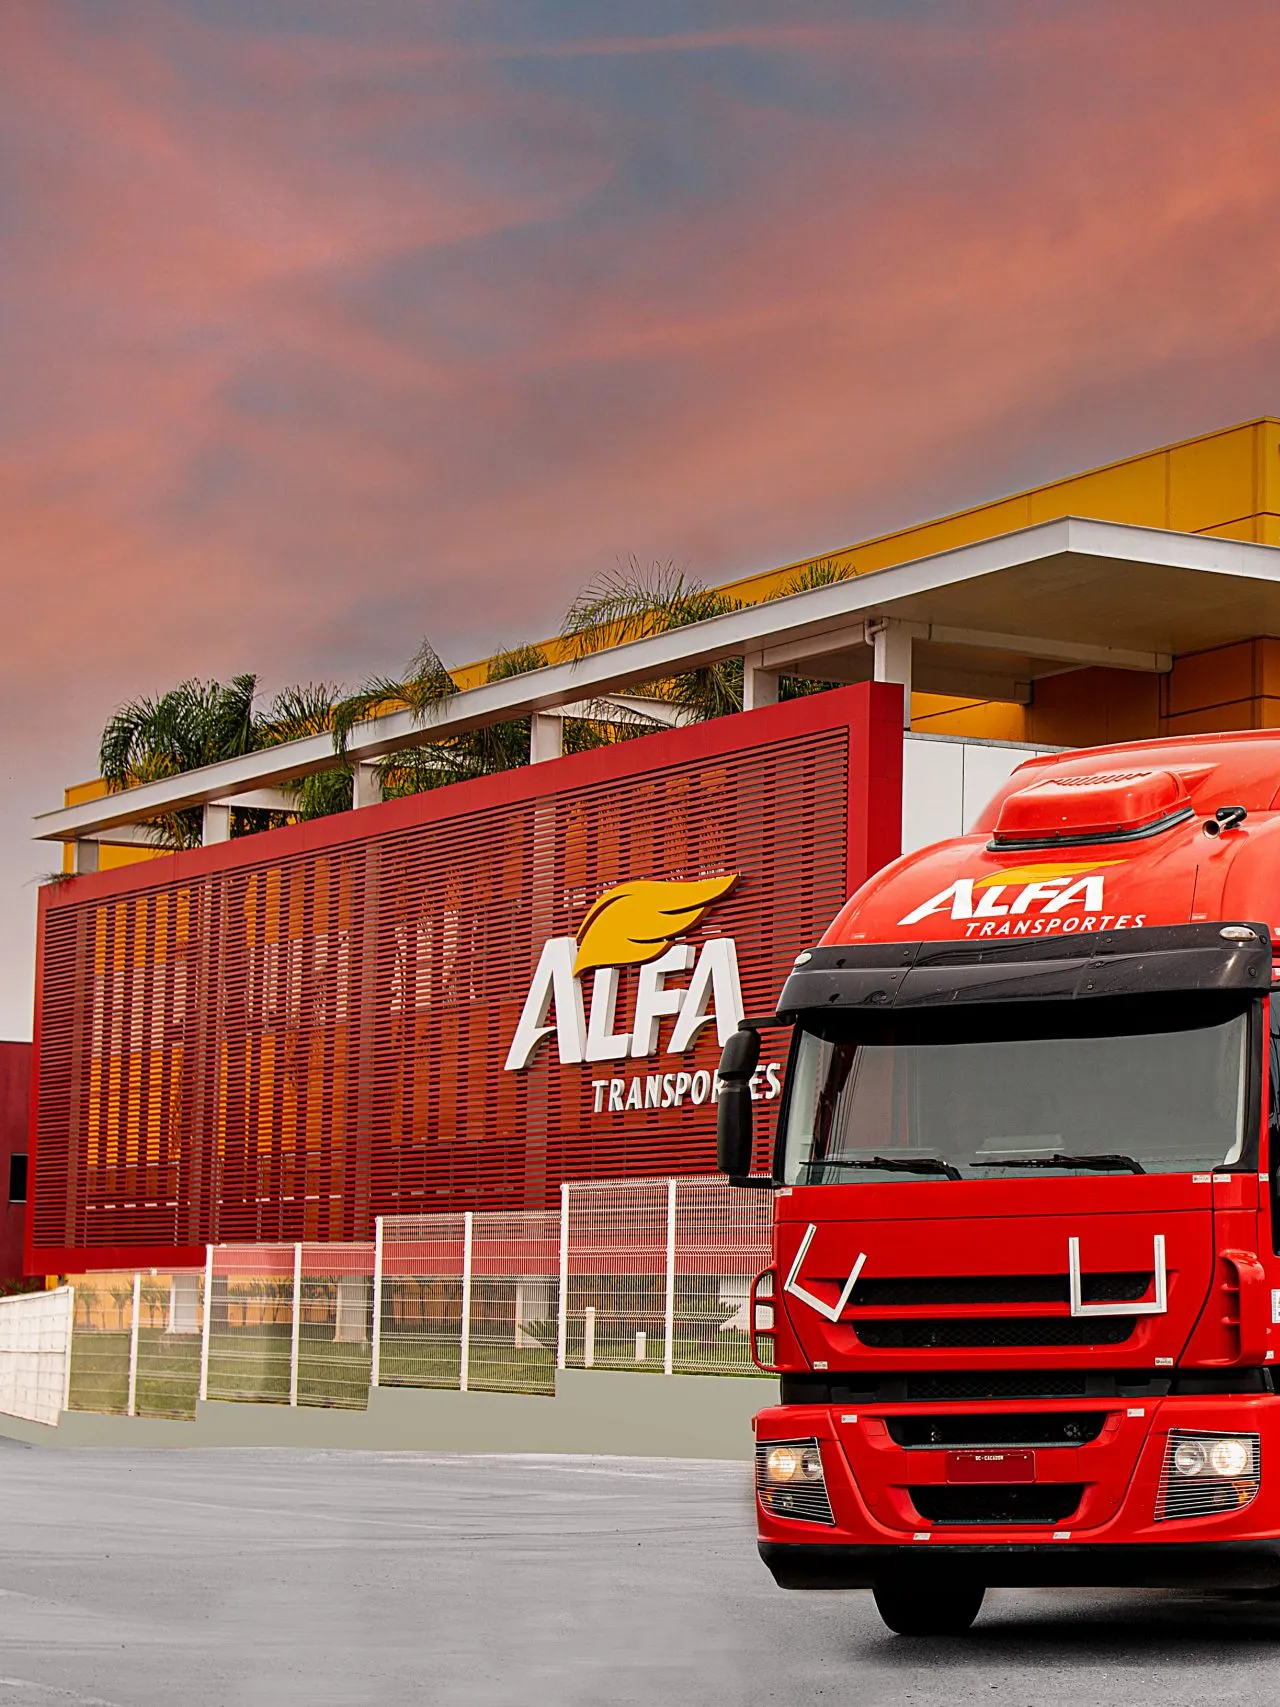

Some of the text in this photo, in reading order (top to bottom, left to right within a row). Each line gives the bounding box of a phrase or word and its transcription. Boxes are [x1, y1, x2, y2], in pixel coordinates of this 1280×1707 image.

[897, 876, 1105, 925] ALFA
[964, 914, 1147, 937] TRANSPORTES
[504, 937, 745, 1071] ALFA
[591, 1062, 781, 1113] TRANSPORES
